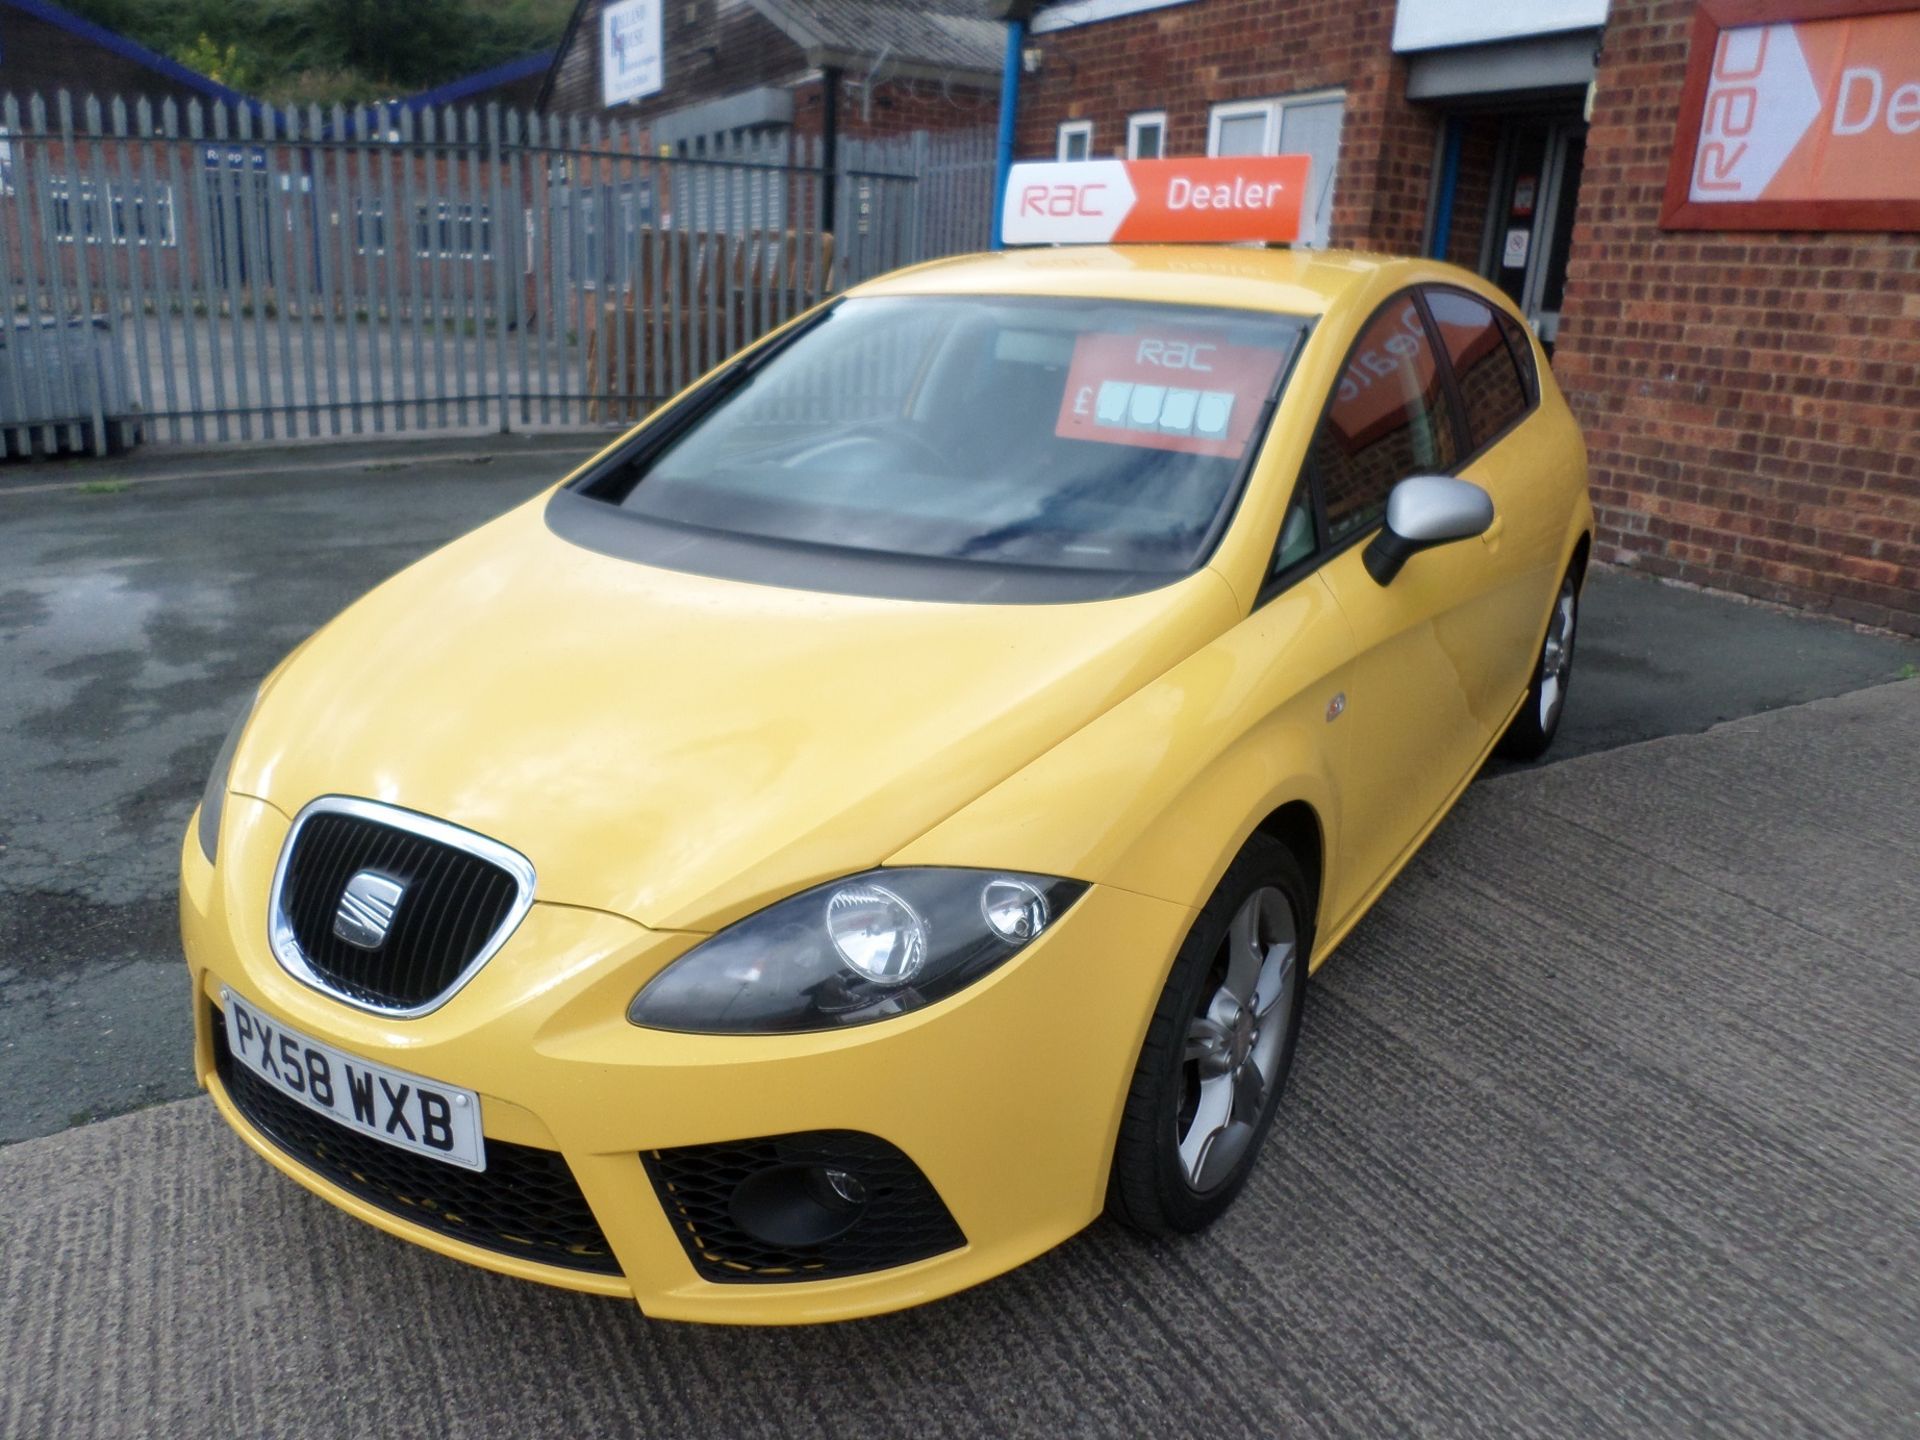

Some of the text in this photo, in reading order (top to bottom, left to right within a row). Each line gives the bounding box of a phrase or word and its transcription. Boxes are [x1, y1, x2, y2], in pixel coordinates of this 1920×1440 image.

[1166, 176, 1283, 210] Dealer
[233, 1001, 454, 1152] PX58 WXB
